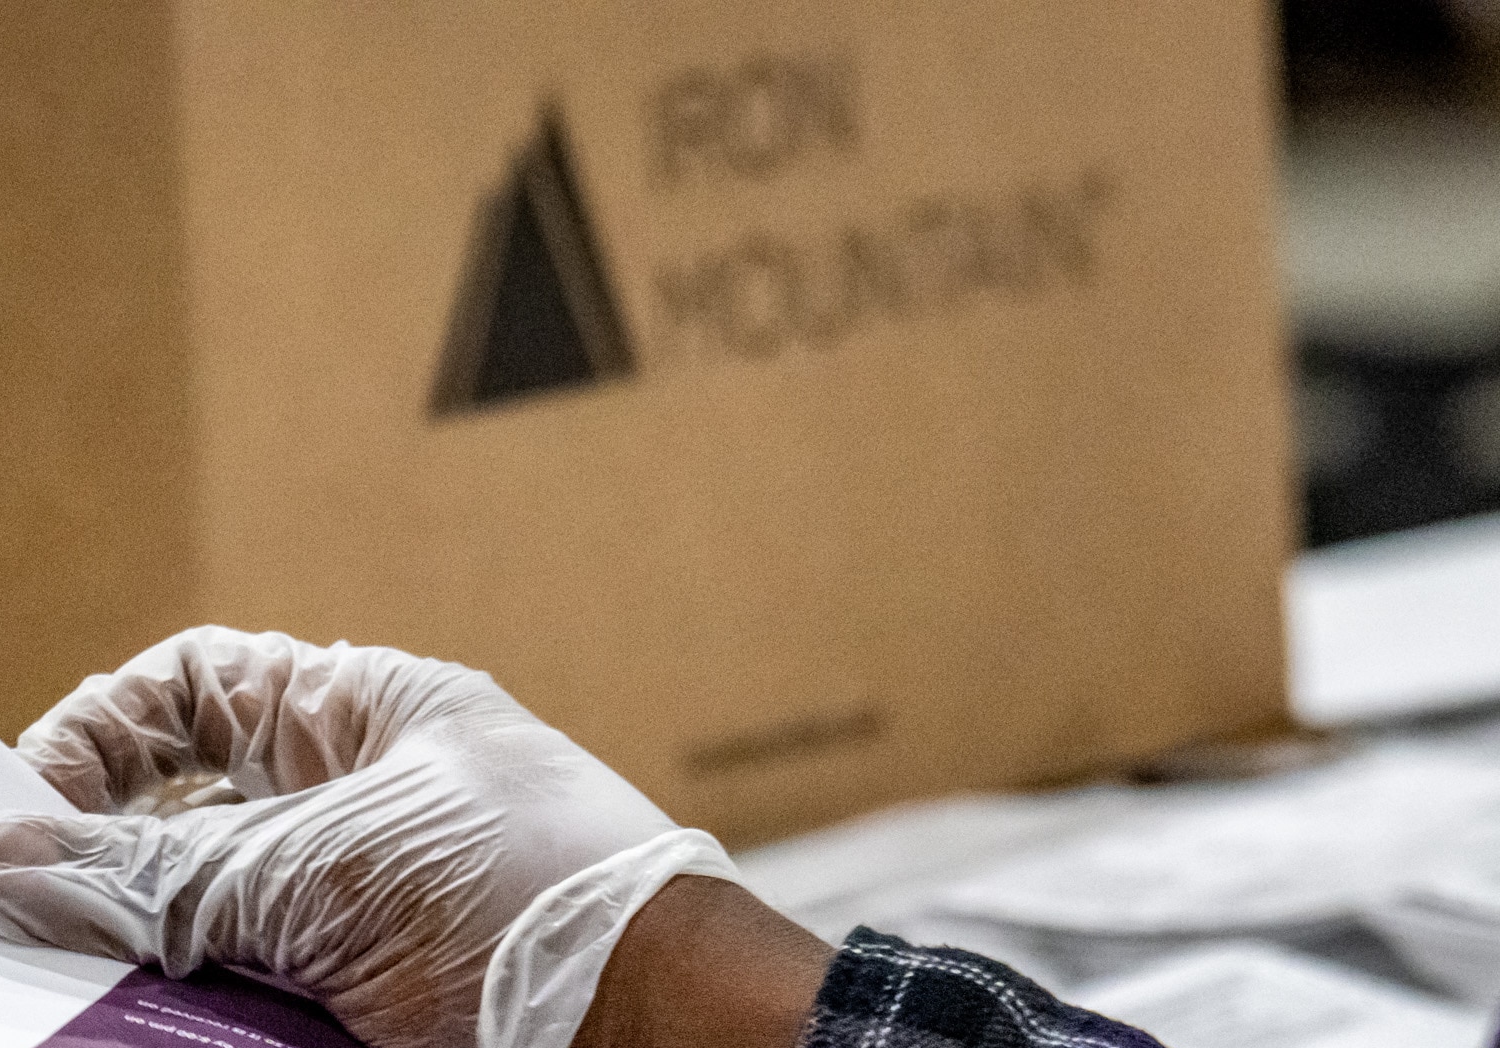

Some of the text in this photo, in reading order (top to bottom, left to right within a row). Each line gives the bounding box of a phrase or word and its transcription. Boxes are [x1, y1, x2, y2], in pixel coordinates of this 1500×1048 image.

[137, 998, 159, 1010] on
[124, 1014, 146, 1025] on
[160, 1006, 230, 1031] received
[148, 1020, 176, 1034] pm
[248, 1031, 262, 1041] it
[264, 1037, 284, 1048] so
